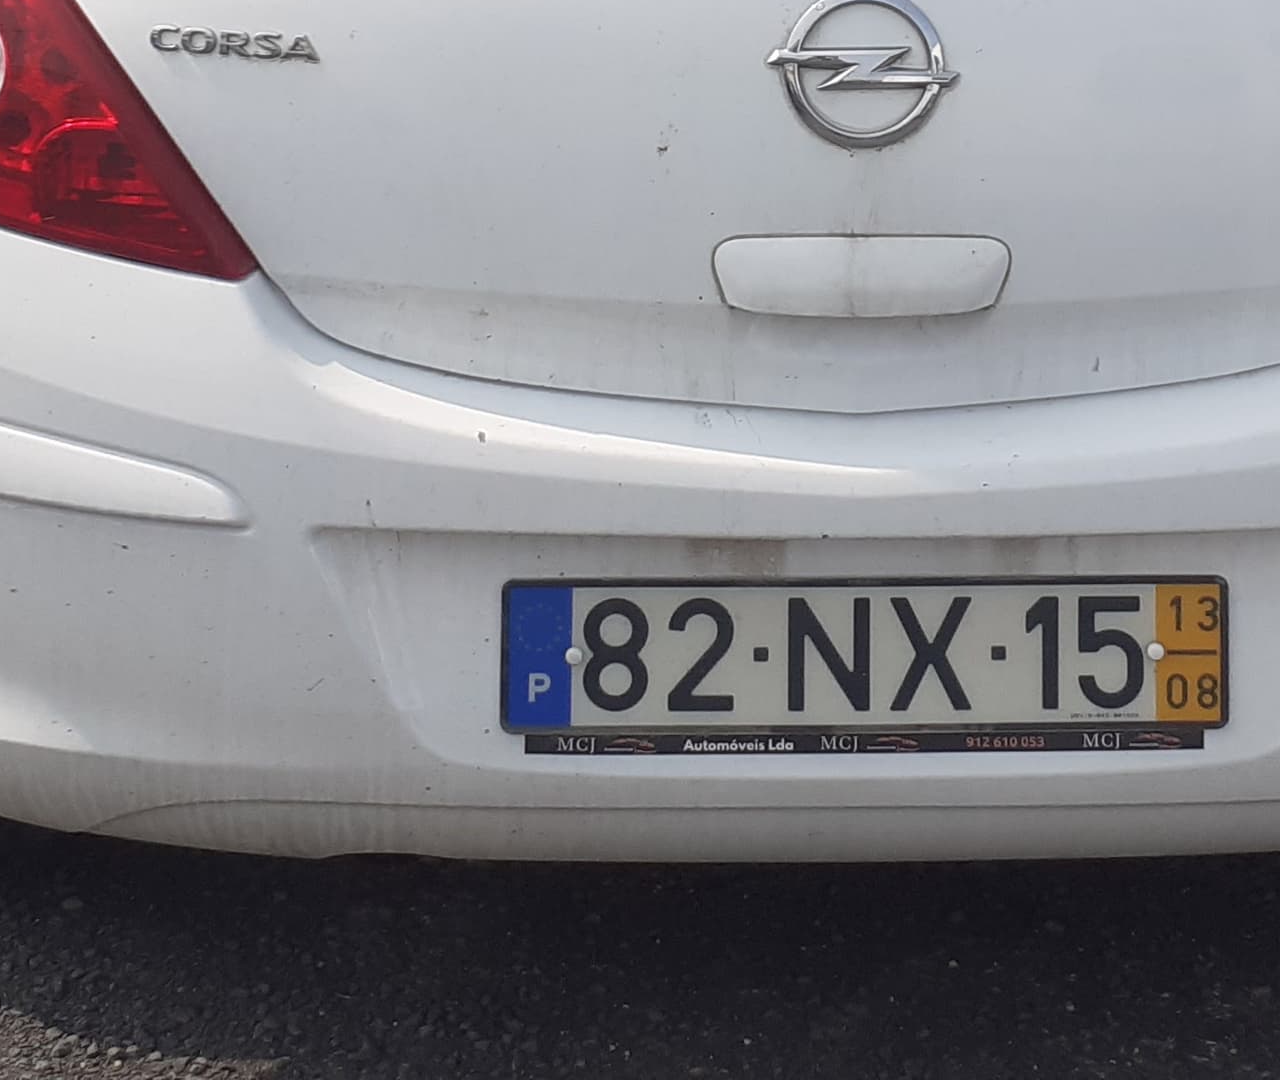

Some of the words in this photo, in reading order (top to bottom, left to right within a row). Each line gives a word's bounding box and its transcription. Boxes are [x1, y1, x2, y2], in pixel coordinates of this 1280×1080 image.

[149, 23, 321, 64] CORSA
[1169, 594, 1219, 633] 13
[527, 672, 552, 703] P
[1166, 672, 1219, 710] 08
[557, 736, 596, 754] MCJ
[683, 737, 766, 752] Automóveis
[768, 738, 795, 752] Lda
[820, 735, 858, 753] MCJ
[966, 736, 991, 748] 912
[993, 736, 1018, 748] 610
[1020, 736, 1046, 748] 053
[1082, 732, 1121, 750] MCJ
